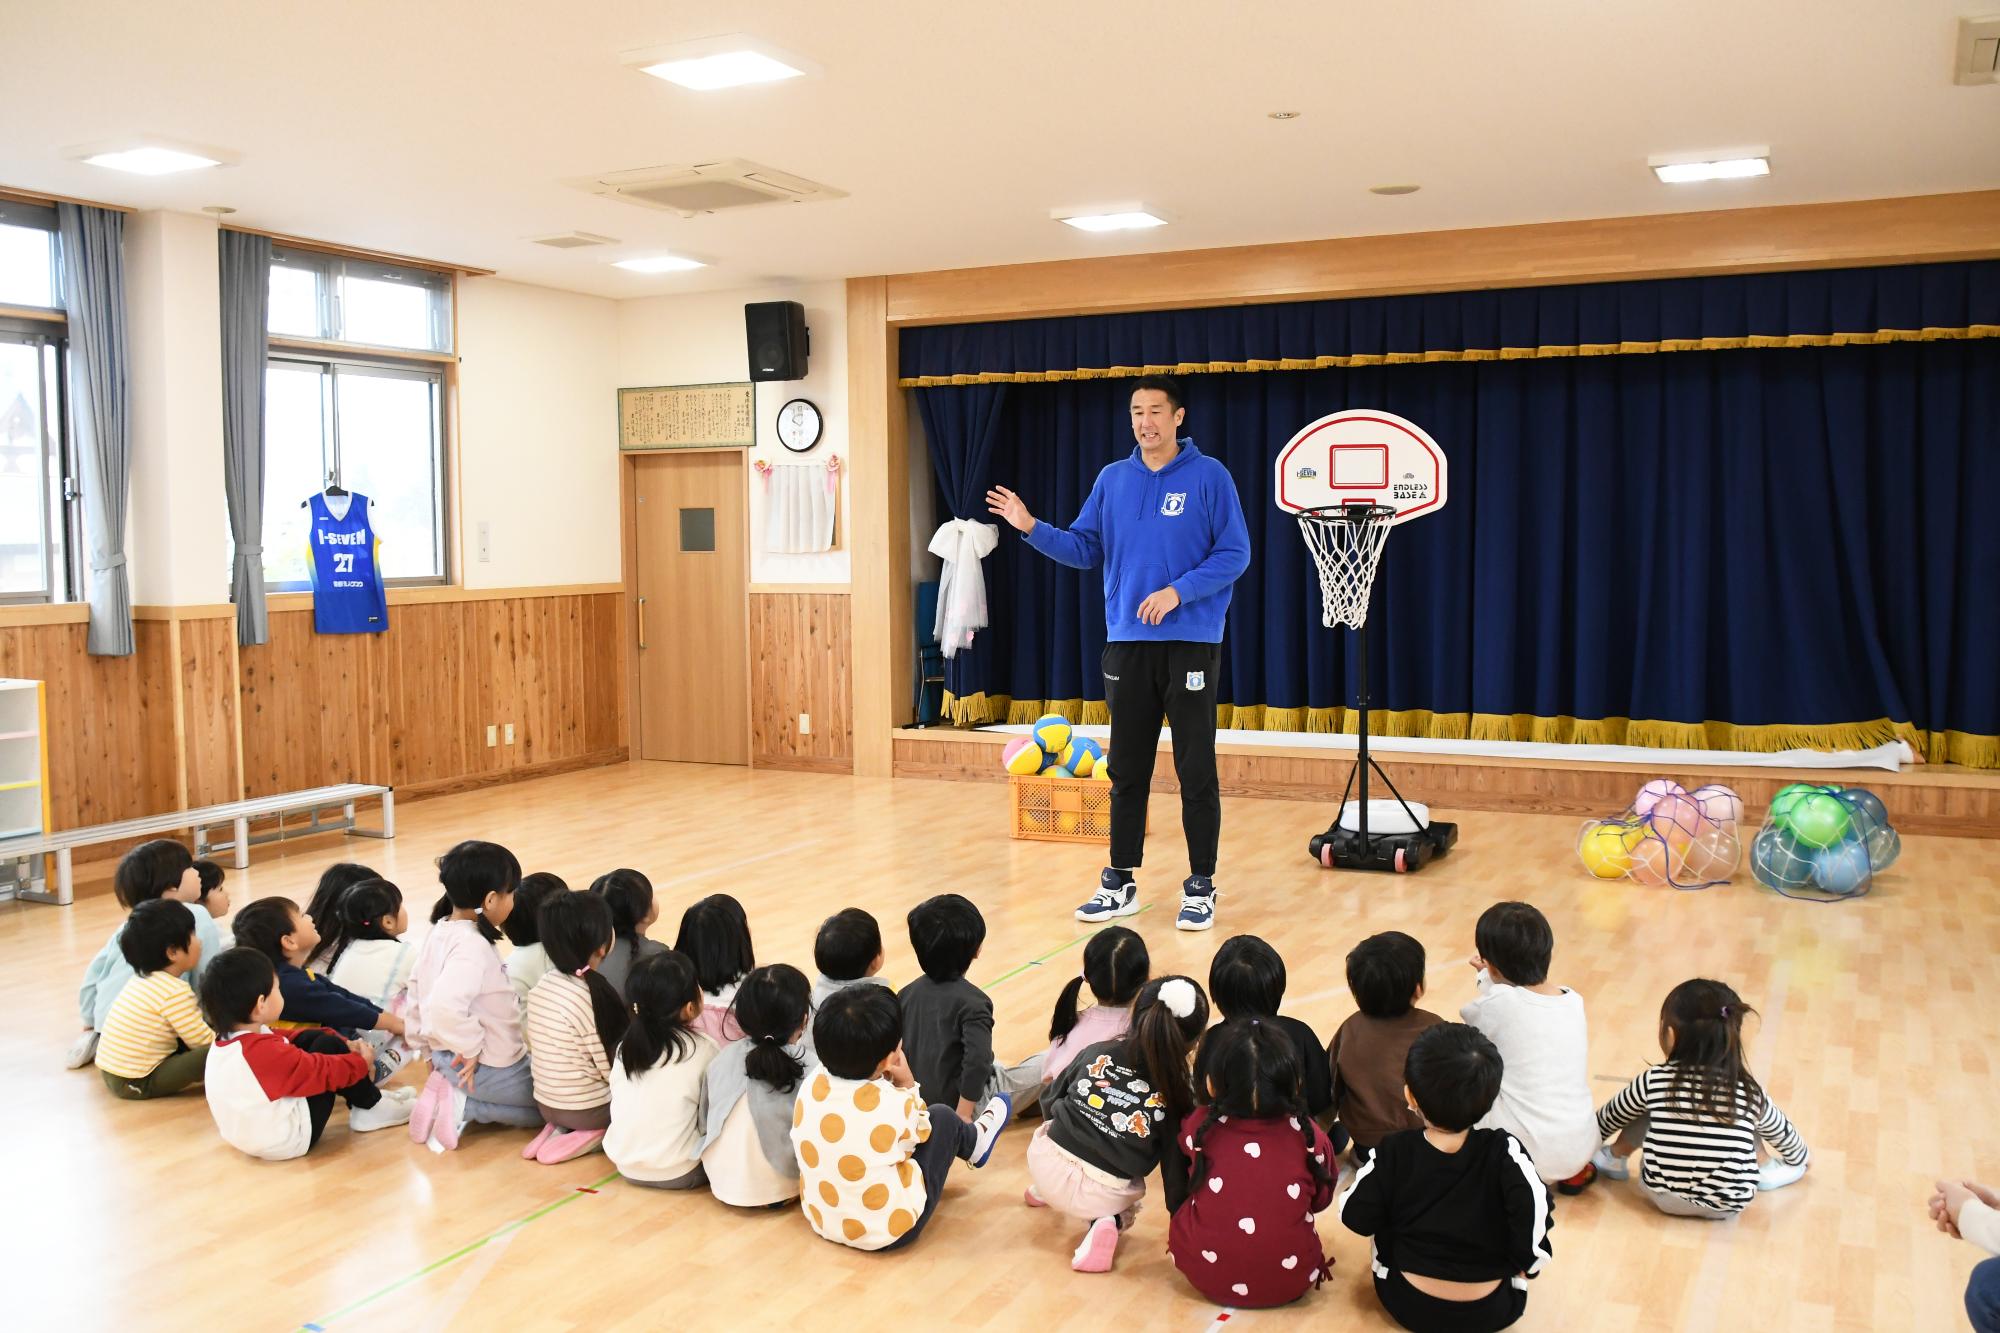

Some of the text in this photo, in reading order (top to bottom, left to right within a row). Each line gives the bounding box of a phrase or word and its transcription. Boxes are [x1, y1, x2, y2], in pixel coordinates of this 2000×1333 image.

[1393, 483, 1428, 491] ENDLESS
[1393, 491, 1417, 499] BASE
[318, 528, 366, 545] I-SEVEN
[333, 553, 354, 573] 27
